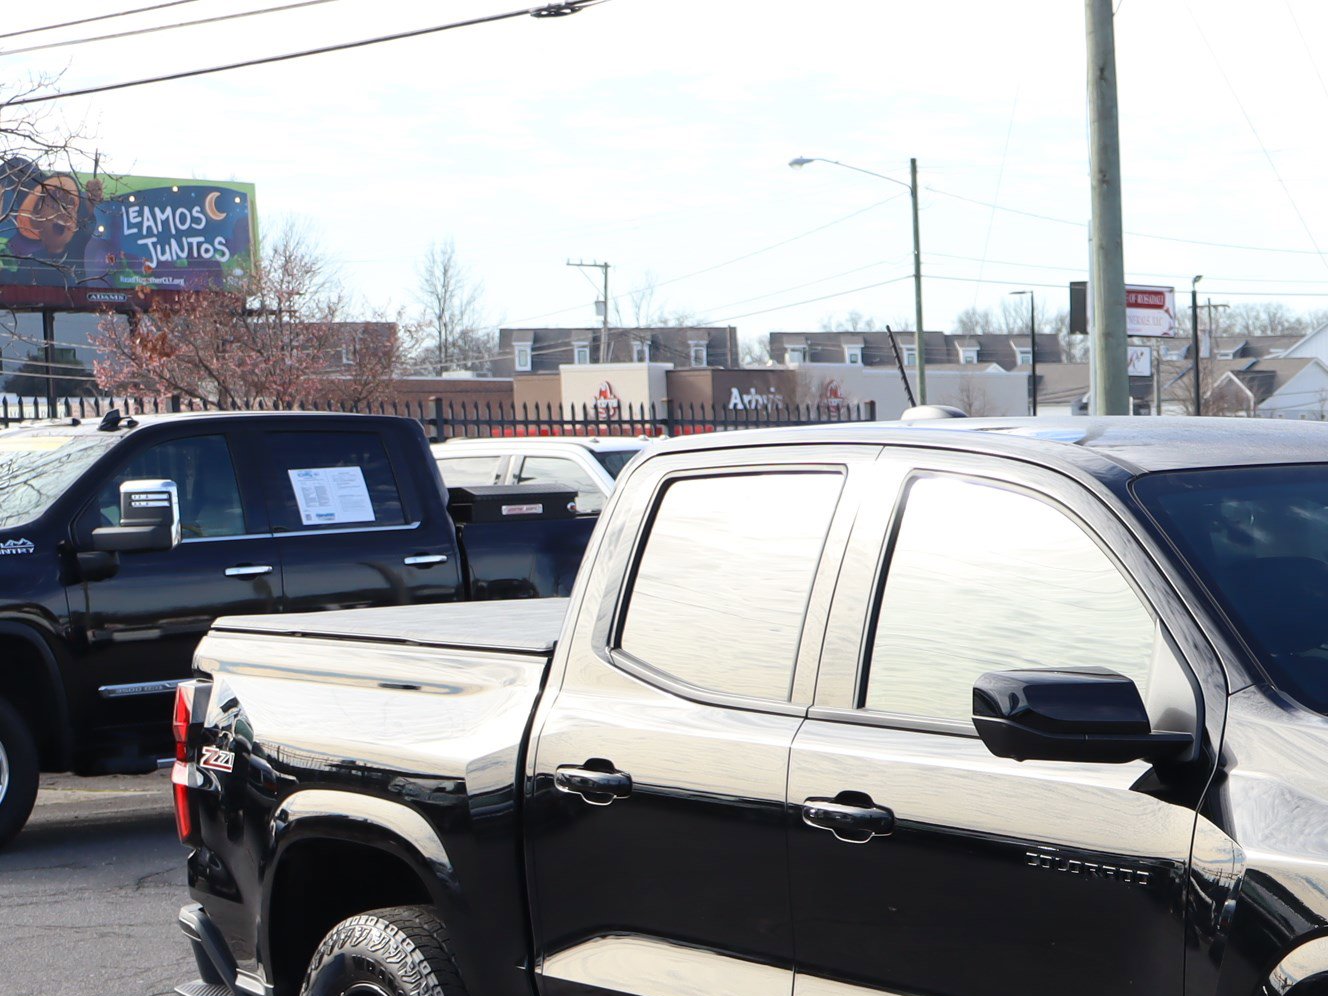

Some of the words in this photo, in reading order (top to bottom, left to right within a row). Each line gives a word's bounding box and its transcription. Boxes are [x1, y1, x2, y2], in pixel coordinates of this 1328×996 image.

[122, 206, 206, 235] LEAMOS
[200, 745, 235, 773] Z71
[1025, 851, 1152, 886] COLORADO
